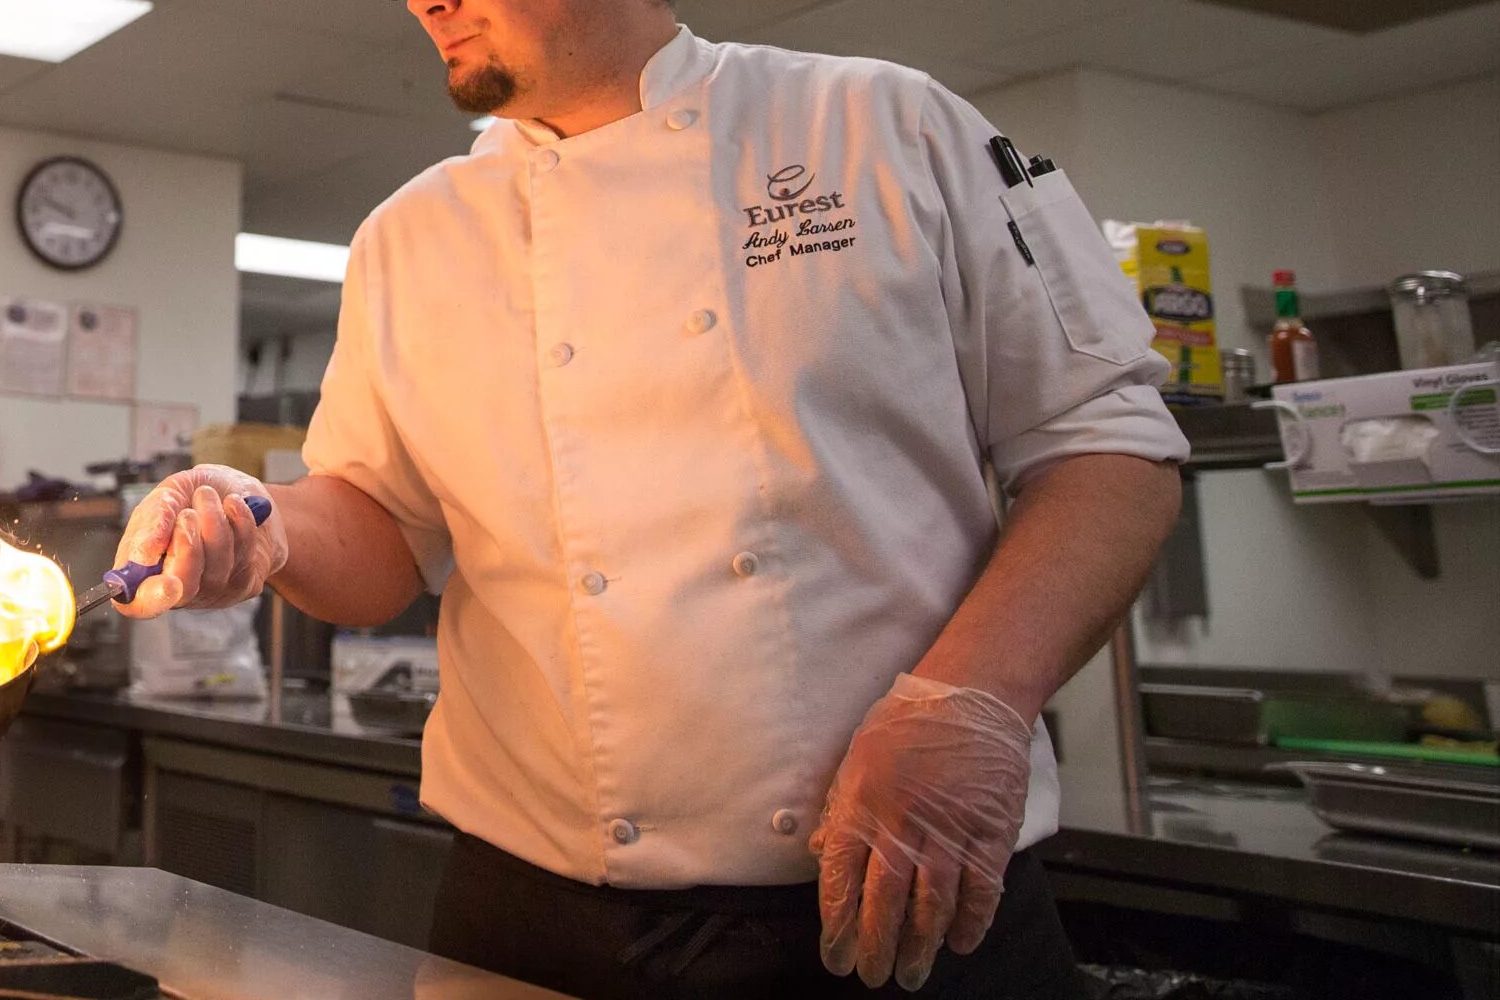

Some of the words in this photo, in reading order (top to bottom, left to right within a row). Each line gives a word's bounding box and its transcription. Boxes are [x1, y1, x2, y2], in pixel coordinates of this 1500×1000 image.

[743, 191, 845, 228] Eurest
[742, 229, 790, 250] Andy
[796, 219, 856, 237] Larsen
[745, 249, 782, 268] Chef
[789, 237, 856, 257] Manager
[1413, 376, 1443, 389] Vinyl
[1446, 373, 1489, 386] Gloves
